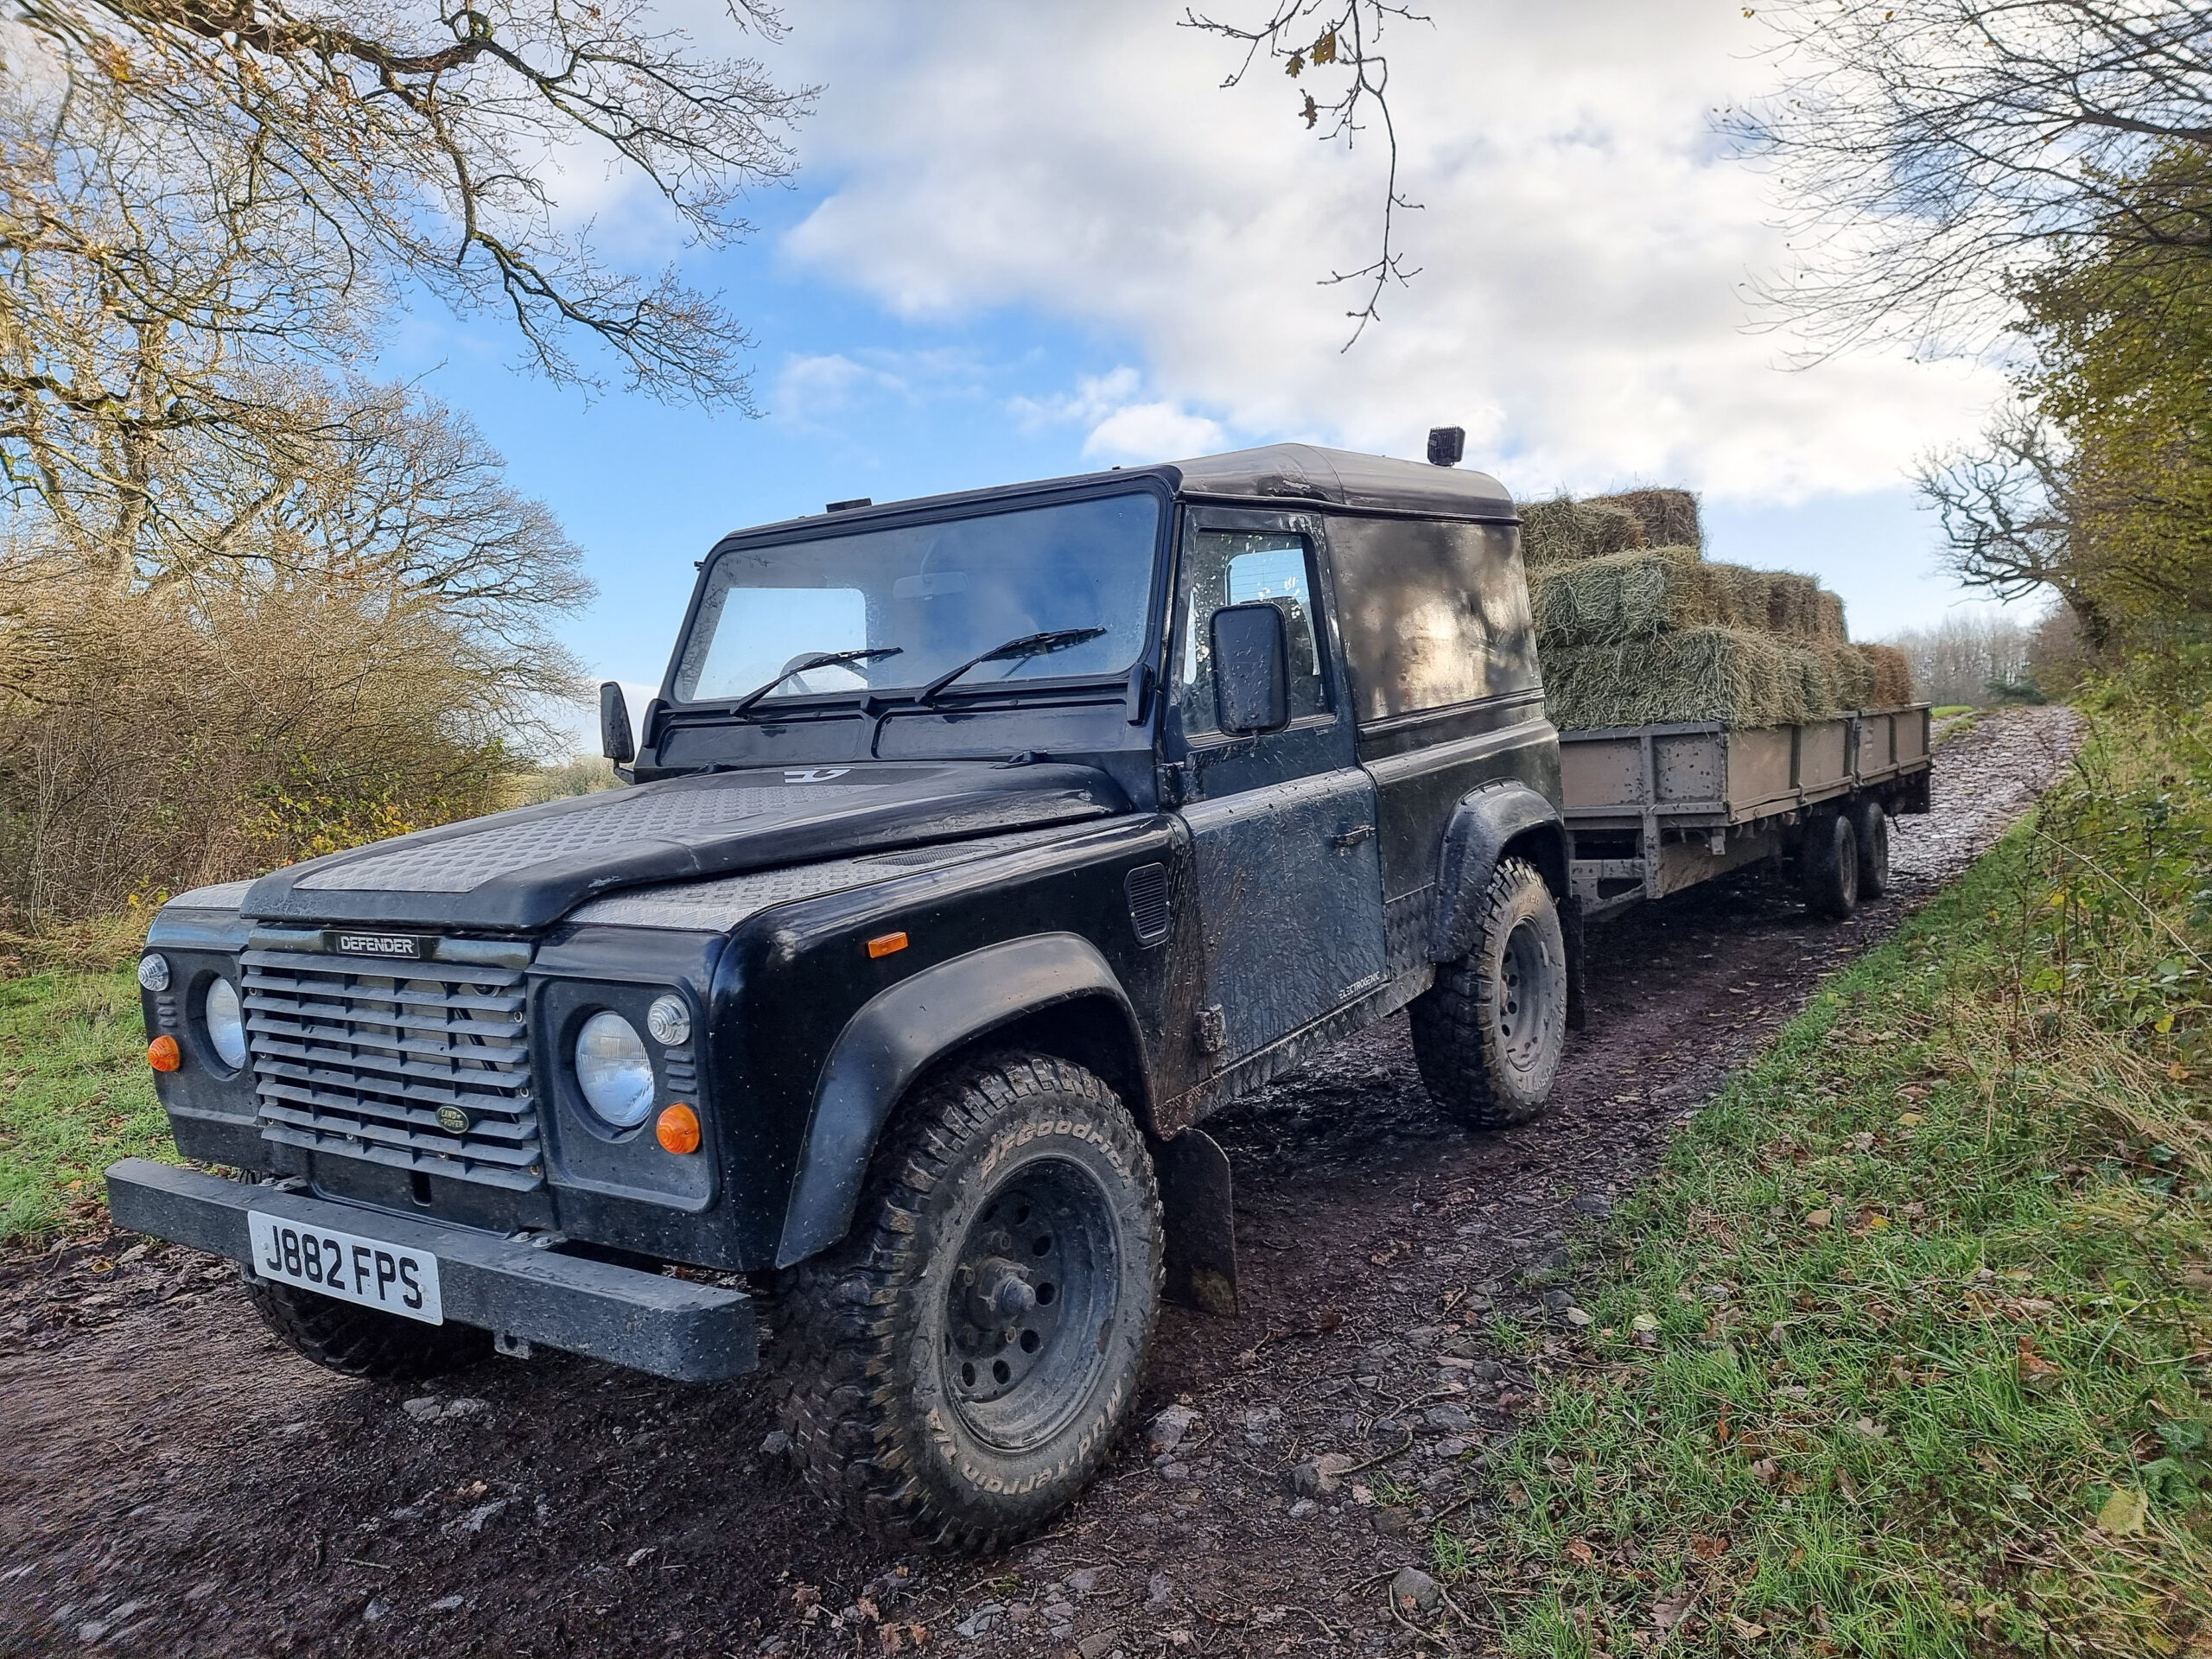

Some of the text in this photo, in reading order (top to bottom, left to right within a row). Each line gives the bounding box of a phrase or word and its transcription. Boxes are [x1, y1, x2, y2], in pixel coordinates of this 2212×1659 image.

[340, 936, 415, 954] DEFENDER
[1338, 970, 1381, 1000] ELECTROGENIC
[266, 1224, 423, 1310] J882 FPS
